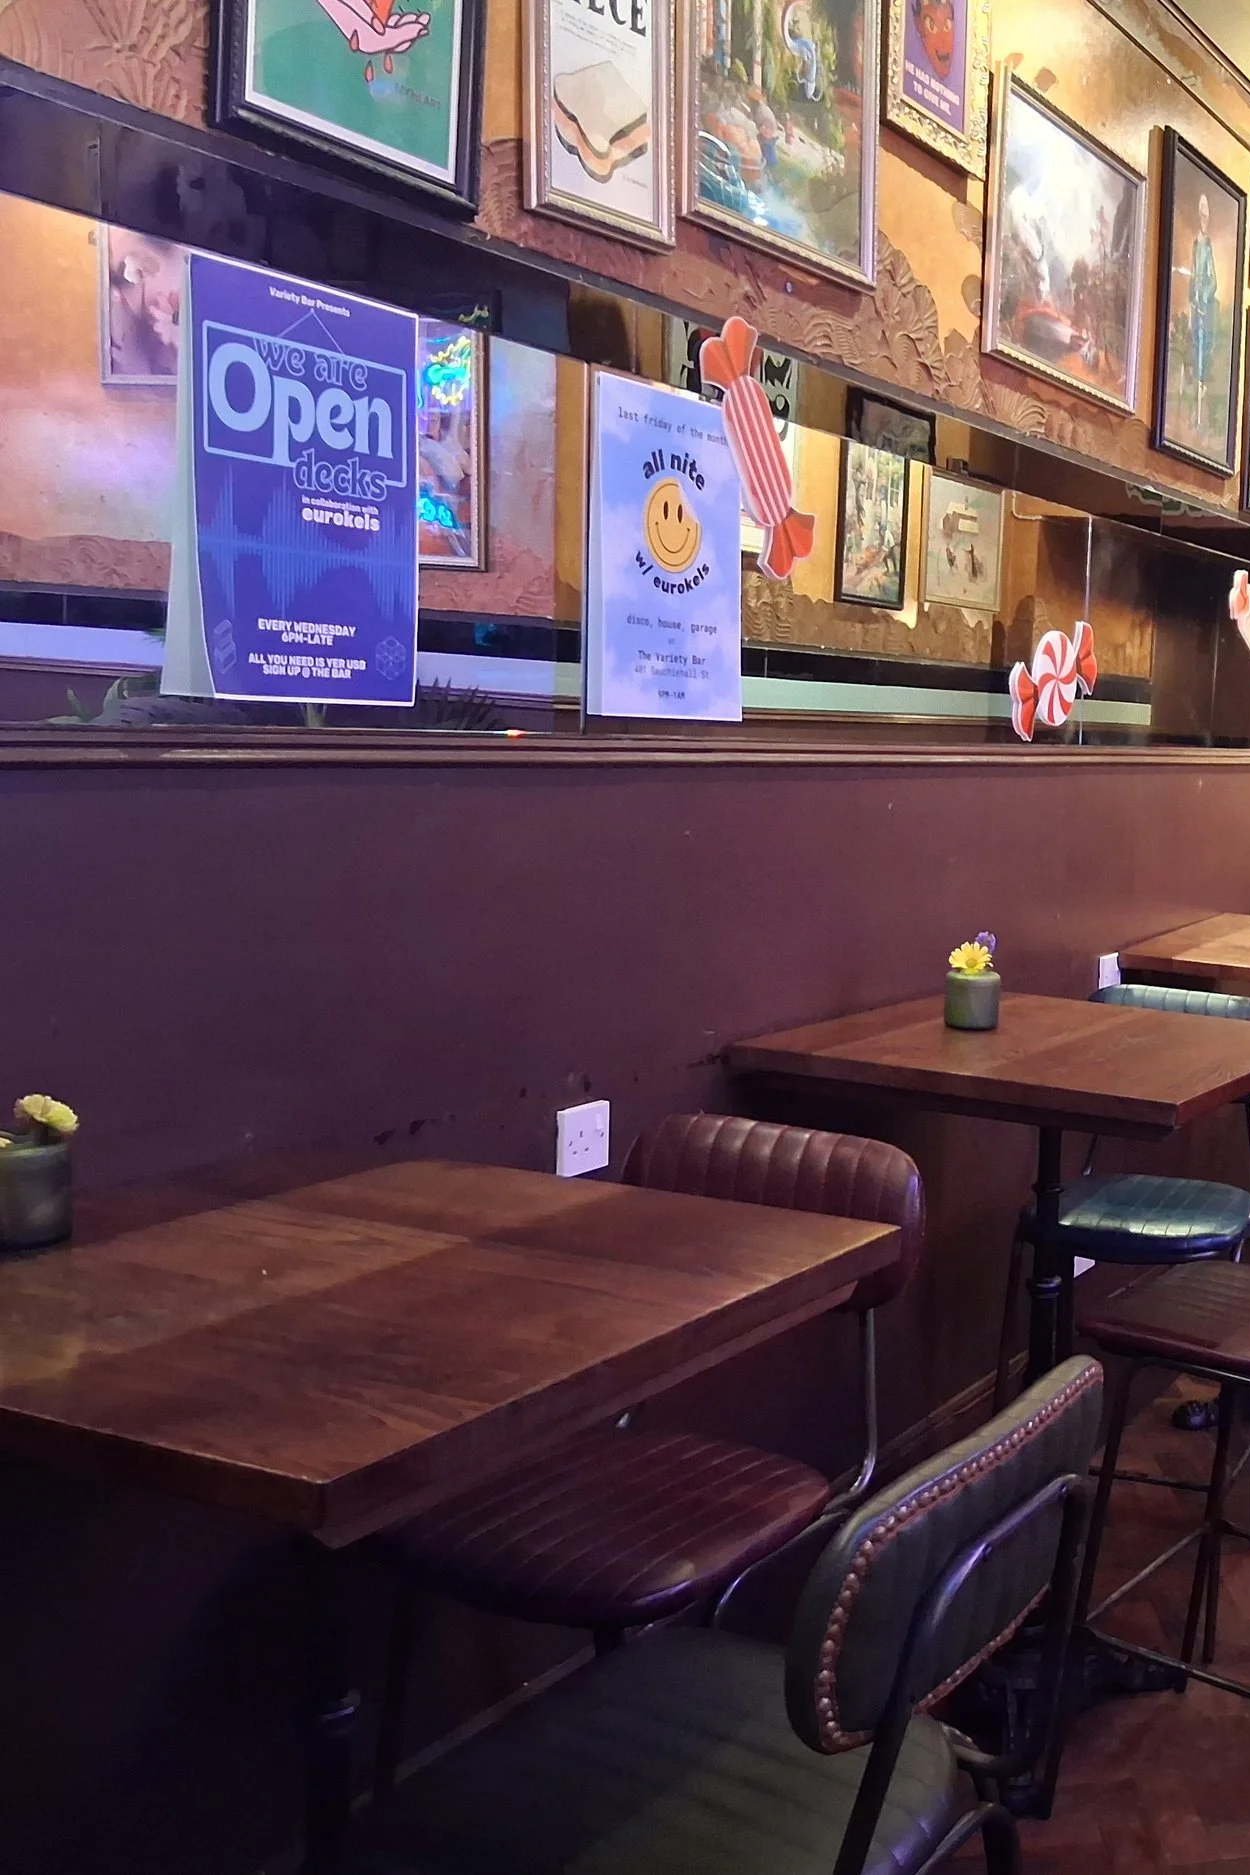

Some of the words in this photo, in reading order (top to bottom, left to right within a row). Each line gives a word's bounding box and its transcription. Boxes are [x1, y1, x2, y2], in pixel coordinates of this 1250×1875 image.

[913, 80, 923, 95] TO
[269, 286, 300, 304] Variety
[301, 295, 316, 307] Bar
[316, 299, 350, 317] Presents
[254, 338, 306, 377] we
[314, 353, 369, 391] are
[208, 342, 394, 470] Open
[618, 406, 639, 423] last
[644, 413, 673, 433] friday
[676, 423, 686, 434] of
[690, 428, 704, 440] the
[293, 448, 388, 501] decks
[642, 449, 666, 480] all
[670, 452, 705, 491] nite
[311, 497, 361, 513] collaboration
[361, 504, 379, 516] with
[258, 618, 292, 632] EVERY
[293, 621, 356, 637] WEDNESDAY
[690, 623, 717, 635] garage
[281, 631, 334, 646] 6PM-LATE
[248, 652, 266, 664] ALL
[267, 653, 288, 665] YOU
[289, 655, 314, 667] NEED
[315, 656, 325, 668] IS
[346, 659, 366, 670] USB
[638, 649, 651, 661] The
[656, 652, 688, 666] Variety
[692, 654, 706, 665] Bar
[263, 663, 286, 675] SIGN
[287, 666, 301, 676] UP
[311, 667, 330, 678] THE
[331, 668, 352, 679] BAR
